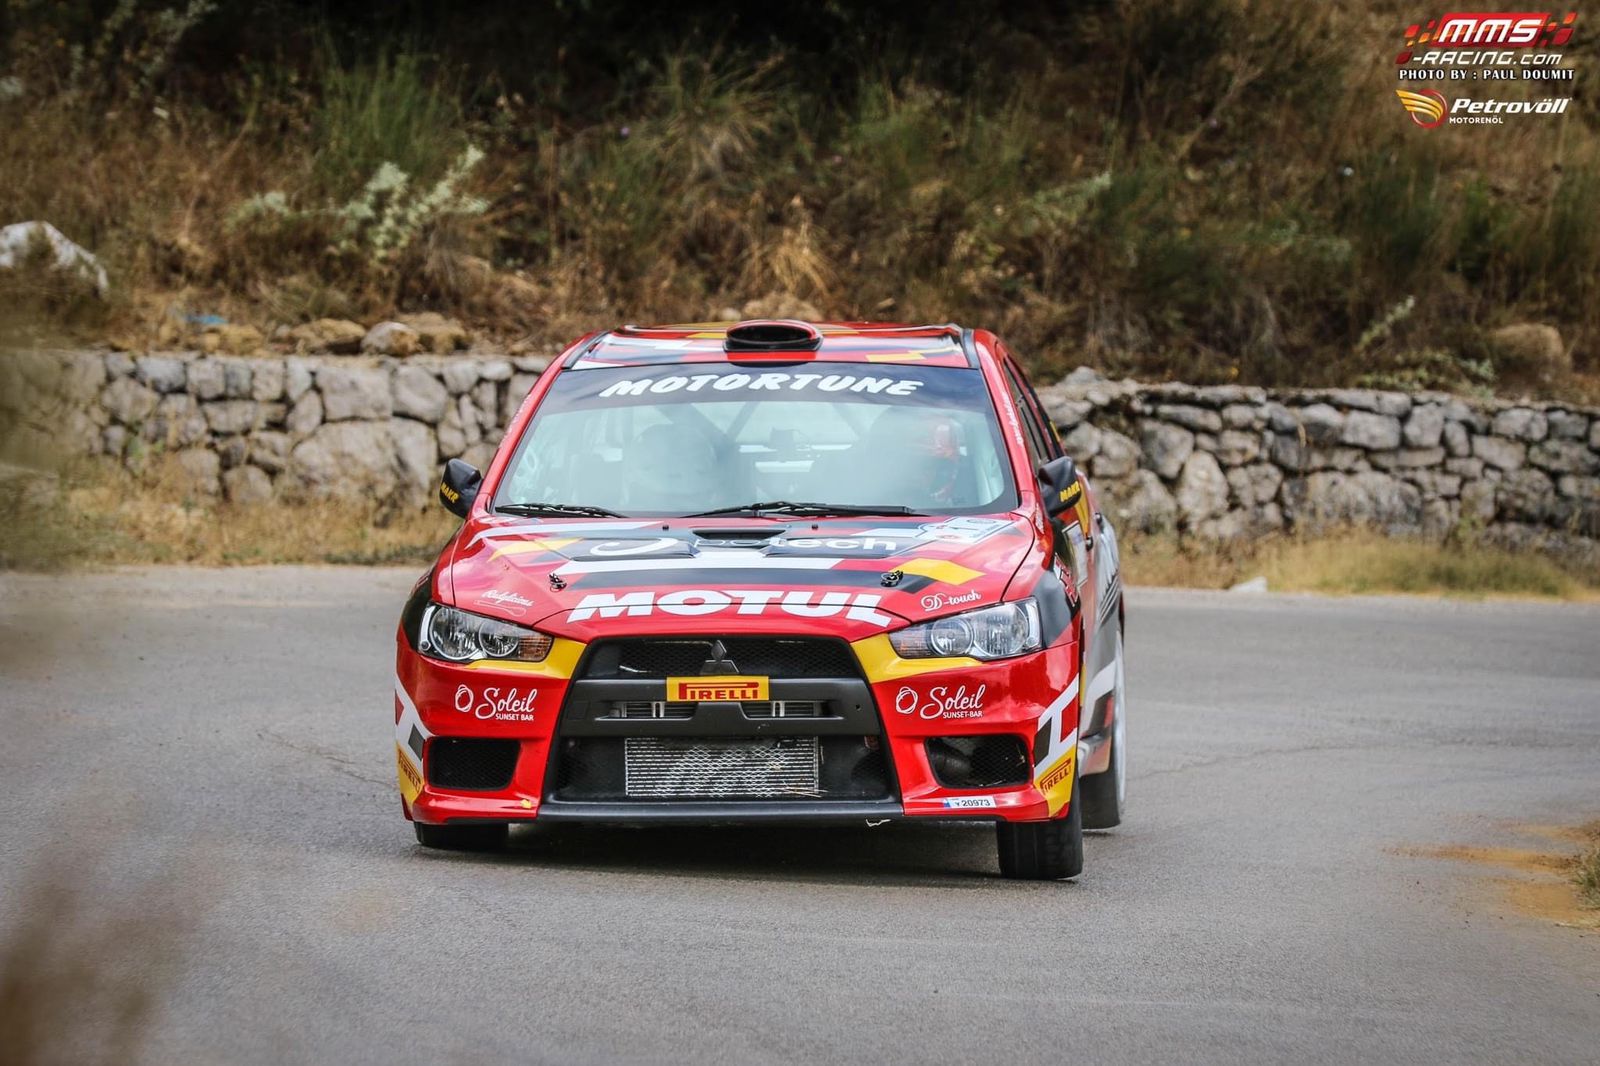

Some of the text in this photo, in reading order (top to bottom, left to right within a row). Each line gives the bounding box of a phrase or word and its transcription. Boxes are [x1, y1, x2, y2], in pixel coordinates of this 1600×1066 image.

[599, 373, 924, 397] MOTORTUNE
[566, 590, 892, 628] MOTUL
[920, 588, 982, 612] D-touch
[474, 686, 538, 720] Soleil
[678, 681, 760, 700] PIRELLI
[919, 684, 986, 720] Soleil
[1039, 756, 1072, 796] PIRELLI
[961, 799, 992, 807] 20973
